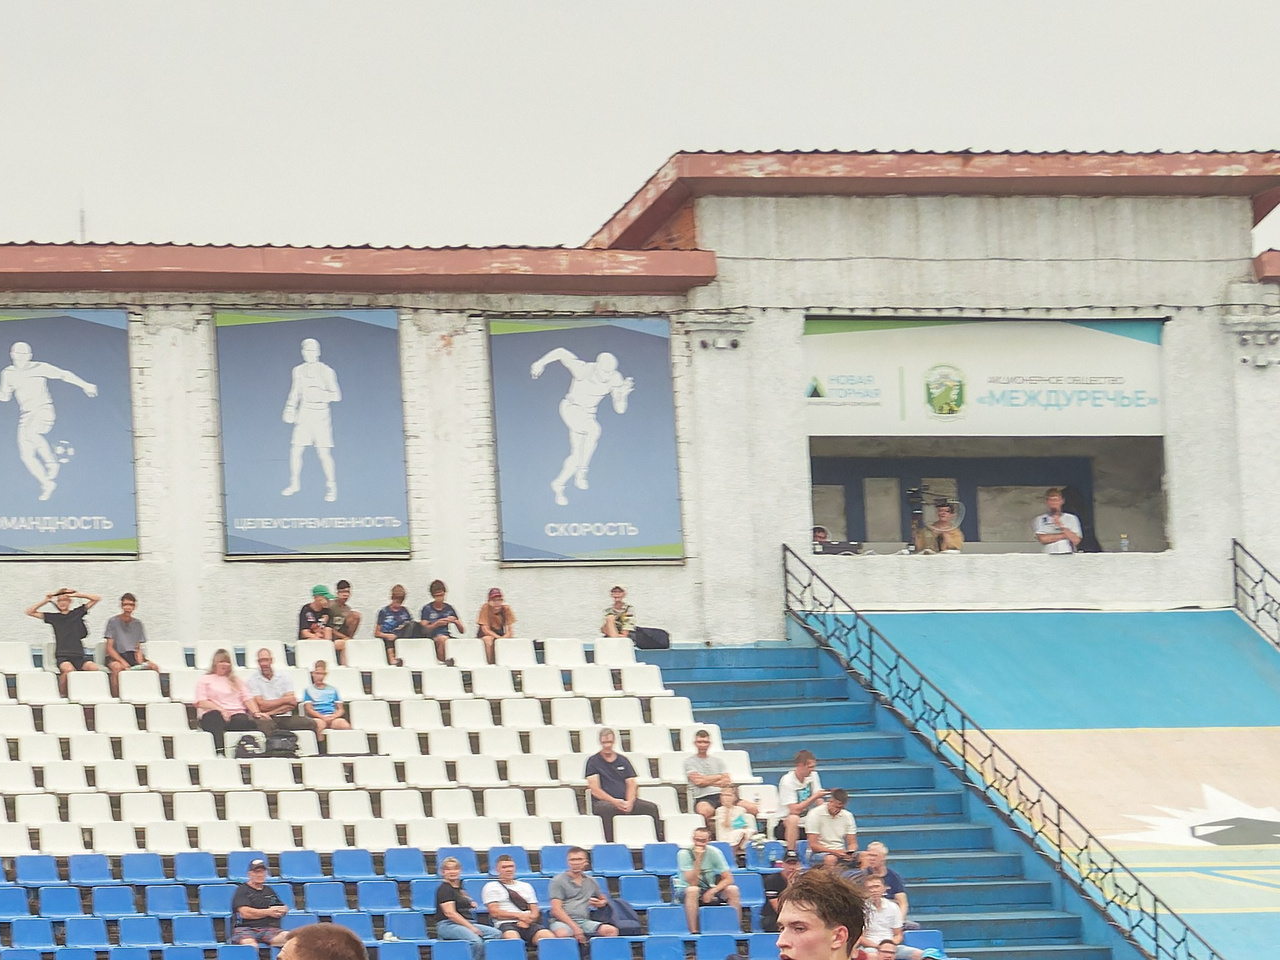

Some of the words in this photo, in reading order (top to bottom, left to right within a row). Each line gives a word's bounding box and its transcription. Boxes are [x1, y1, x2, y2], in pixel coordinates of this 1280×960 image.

[976, 389, 1160, 411] «МЕЖДУРЕЧЬЕ»
[233, 516, 402, 531] ЦЕЛЕУСТРЕМЛЕННОСТЬ
[544, 522, 639, 537] СКОРОСТЬ
